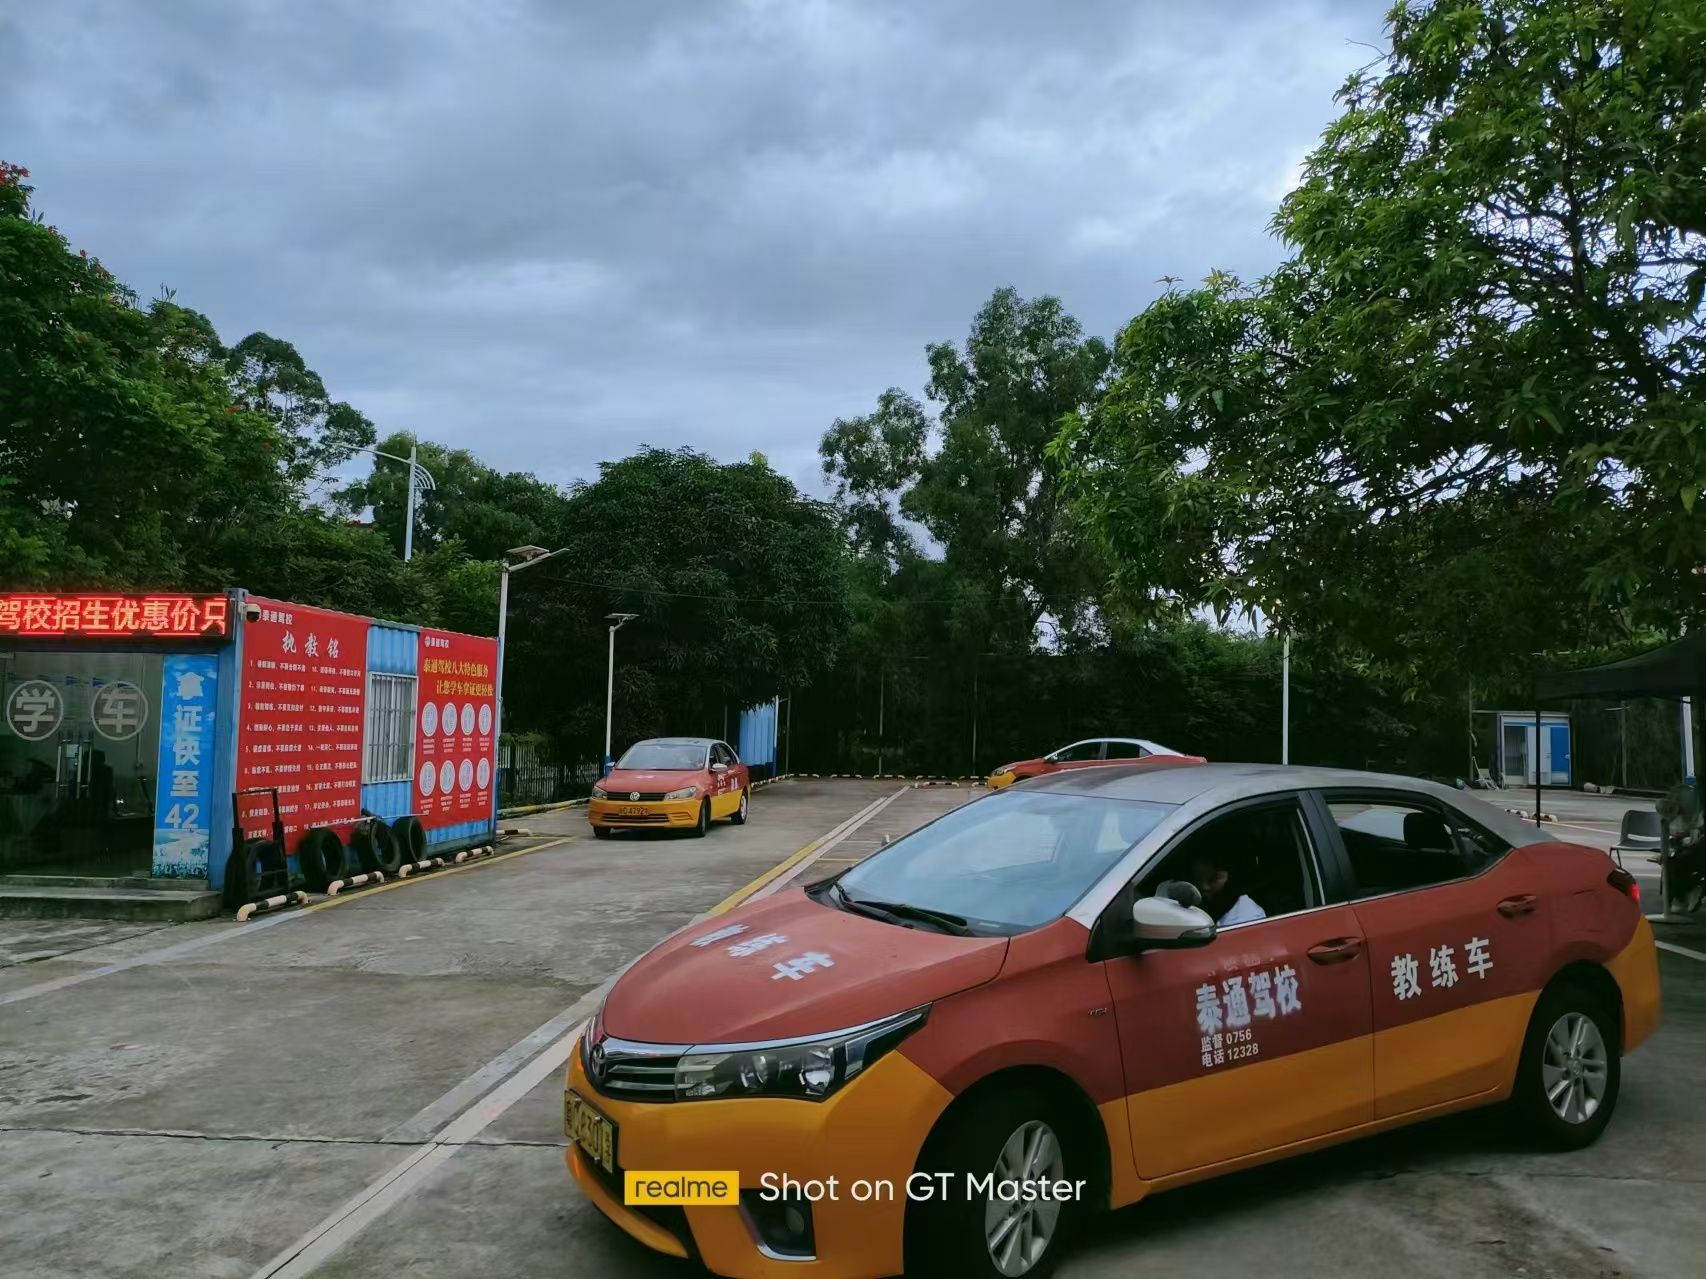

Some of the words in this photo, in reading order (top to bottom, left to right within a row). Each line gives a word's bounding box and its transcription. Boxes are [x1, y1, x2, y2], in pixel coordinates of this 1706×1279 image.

[0, 601, 226, 635] 驾校招生优惠价只
[423, 657, 489, 678] 泰通驾校八大特色服务
[14, 688, 55, 733] 学
[98, 690, 137, 733] 车
[164, 671, 204, 860] 拿证快至42
[1390, 937, 1494, 1000] 教练车
[1196, 964, 1302, 1036] 泰通驾校
[1201, 1034, 1223, 1053] 监督
[1226, 1029, 1252, 1044] 0756
[1202, 1049, 1225, 1067] 电话
[1227, 1043, 1259, 1060] 12328
